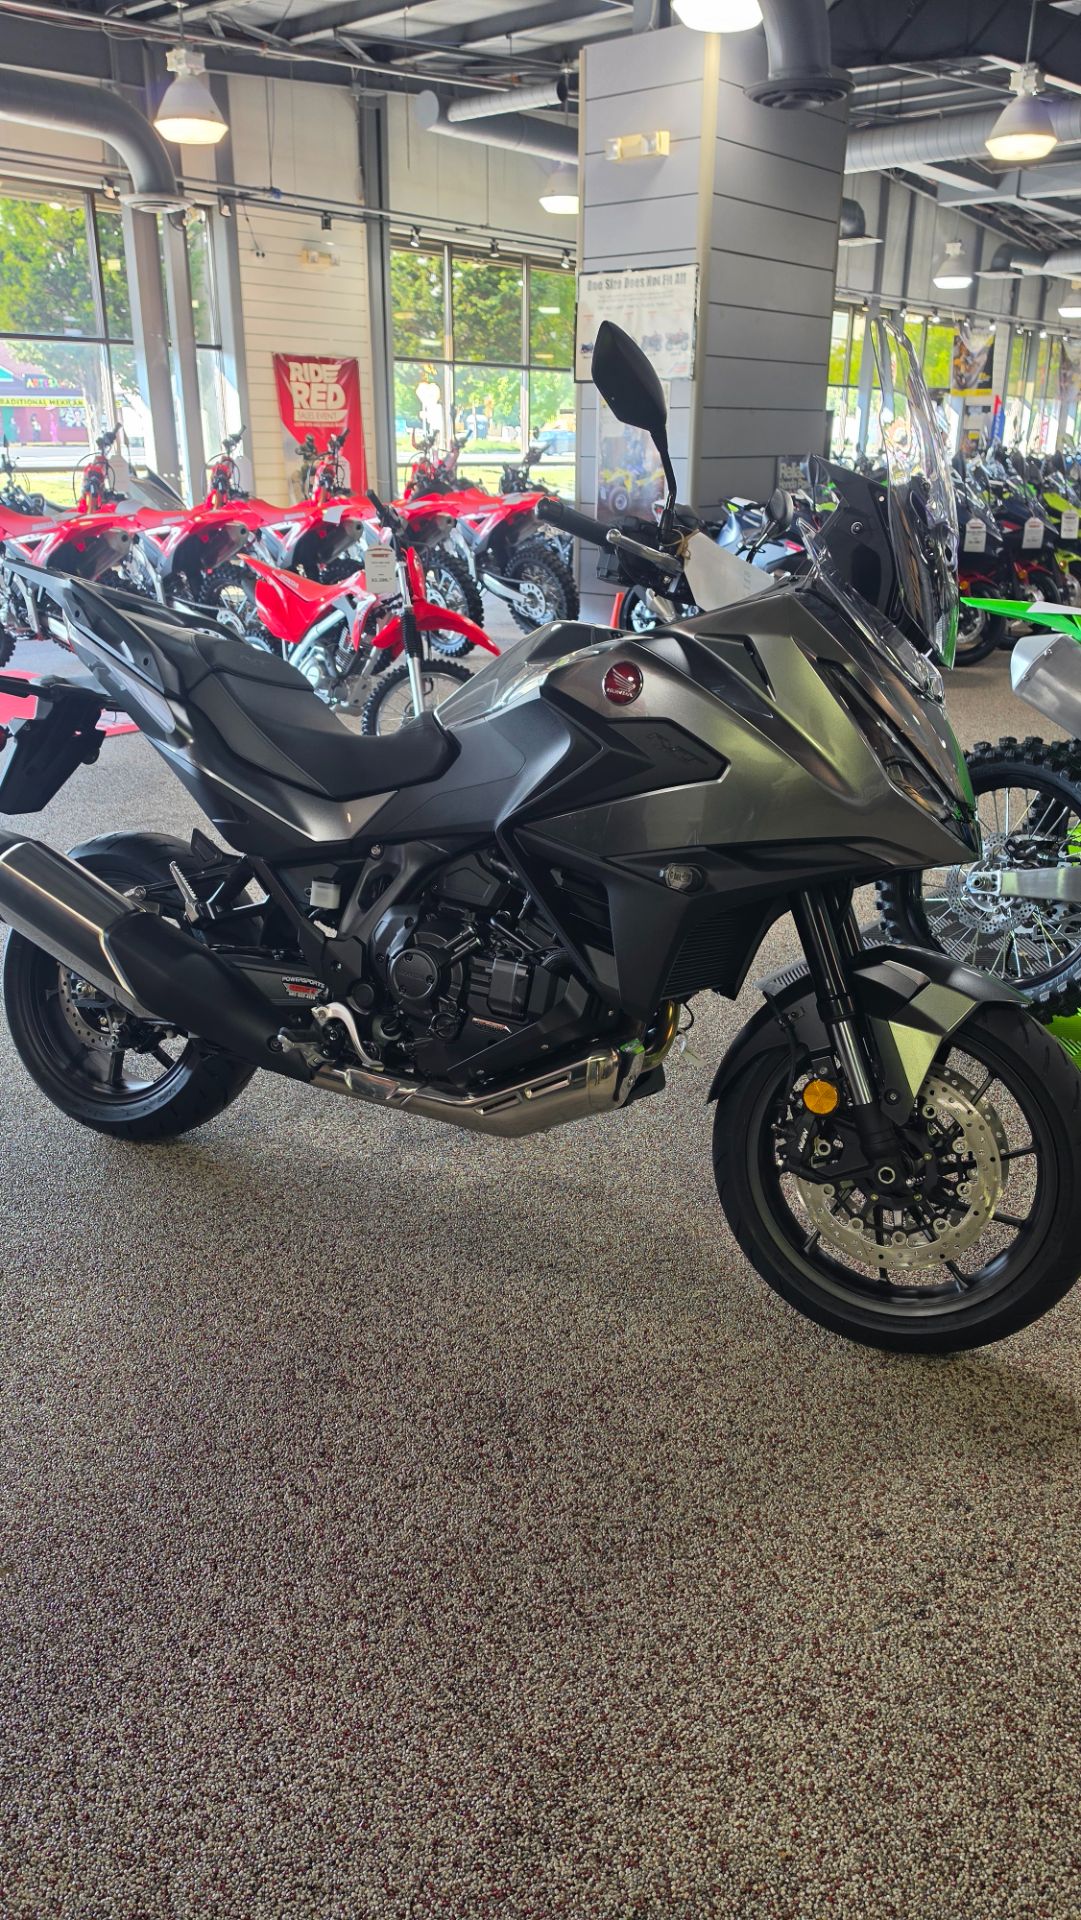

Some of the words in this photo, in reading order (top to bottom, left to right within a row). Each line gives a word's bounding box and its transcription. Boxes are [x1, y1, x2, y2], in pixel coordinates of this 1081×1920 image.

[624, 277, 646, 289] Does
[646, 275, 660, 287] Not
[662, 274, 673, 285] Fit
[675, 272, 687, 284] All
[288, 362, 342, 383] RIDE
[290, 381, 346, 410] RED
[281, 976, 326, 989] POWERSPORTS
